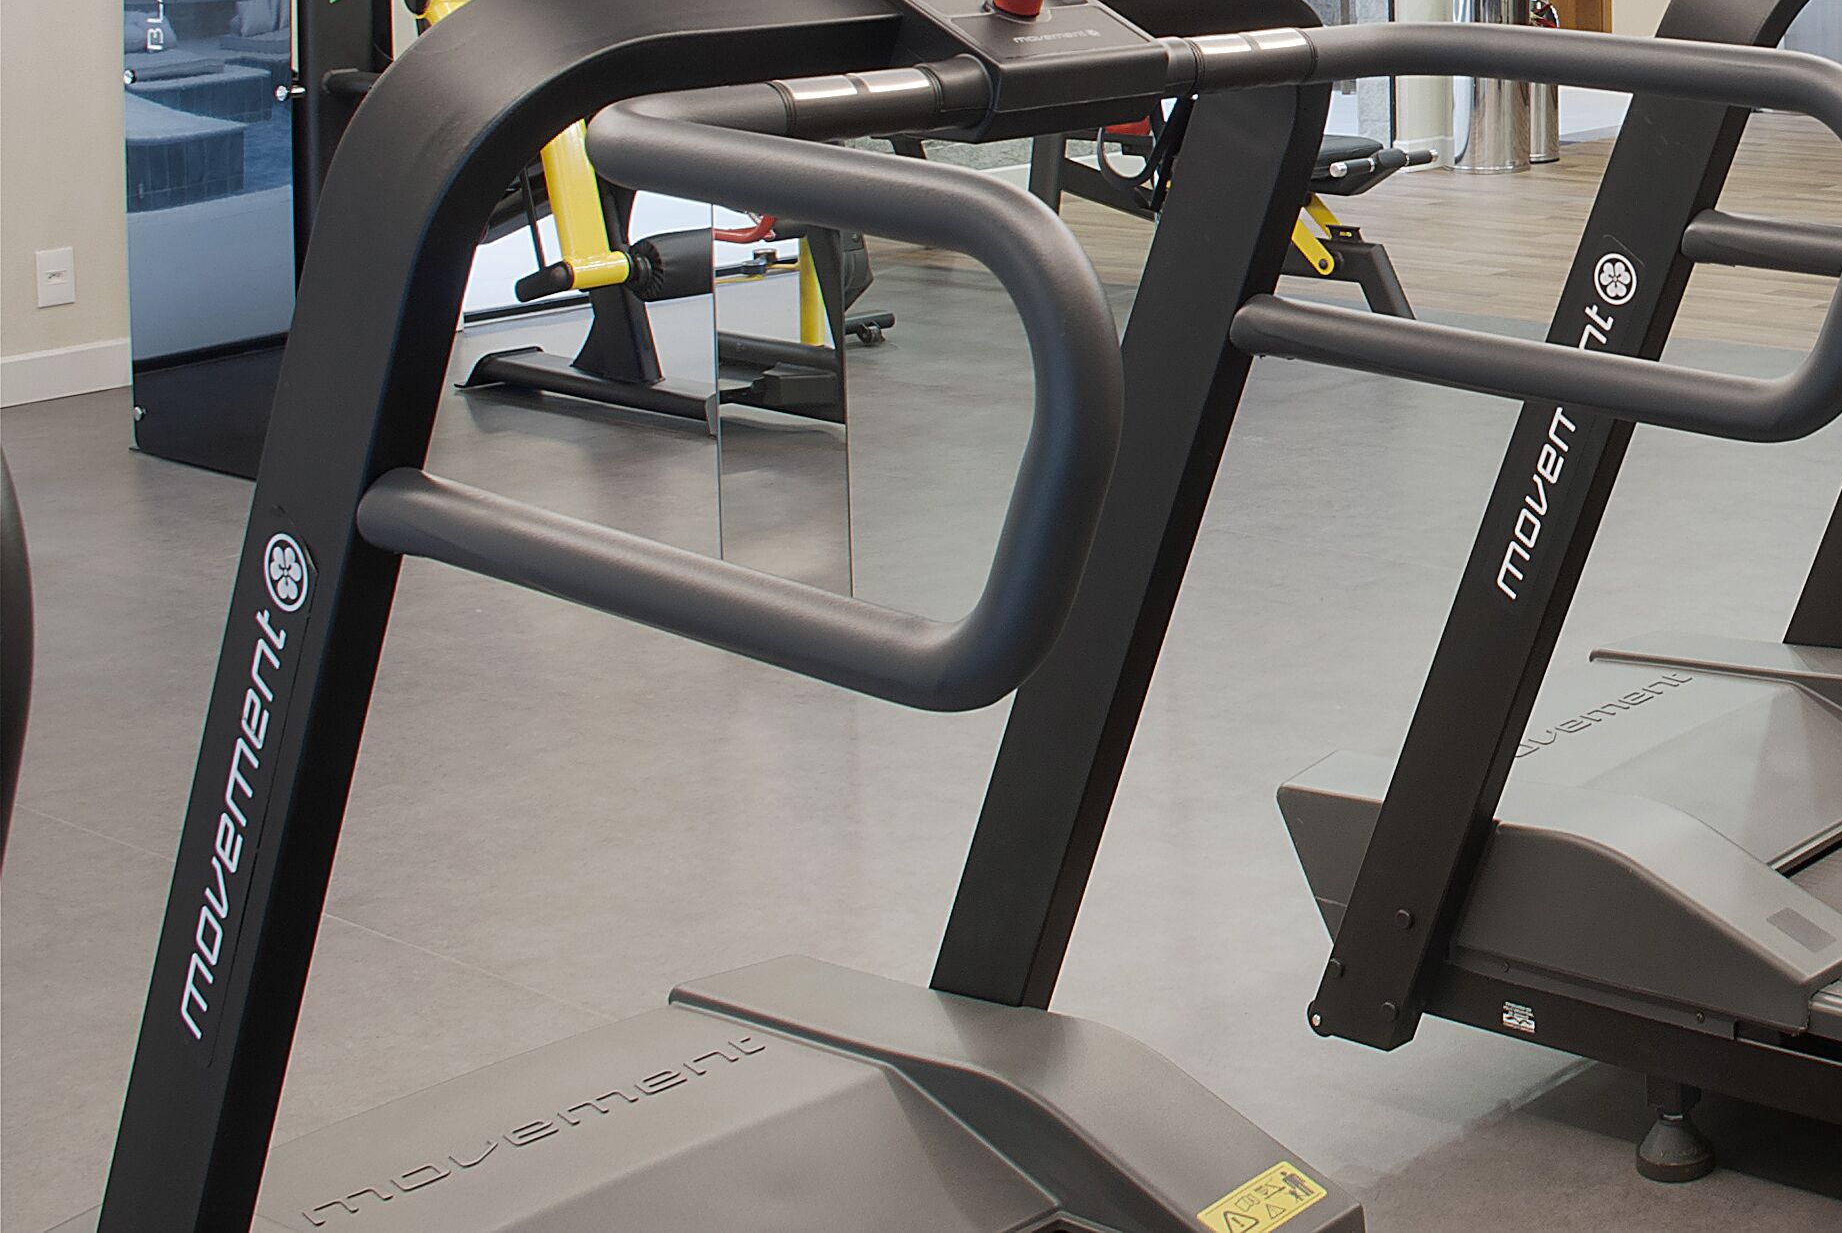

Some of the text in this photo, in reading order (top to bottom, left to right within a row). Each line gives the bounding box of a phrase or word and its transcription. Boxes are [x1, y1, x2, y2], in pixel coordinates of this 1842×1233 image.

[1496, 304, 1614, 601] movemnt
[180, 608, 288, 1040] movement
[1514, 672, 1693, 758] ovement
[302, 1036, 766, 1227] movement
